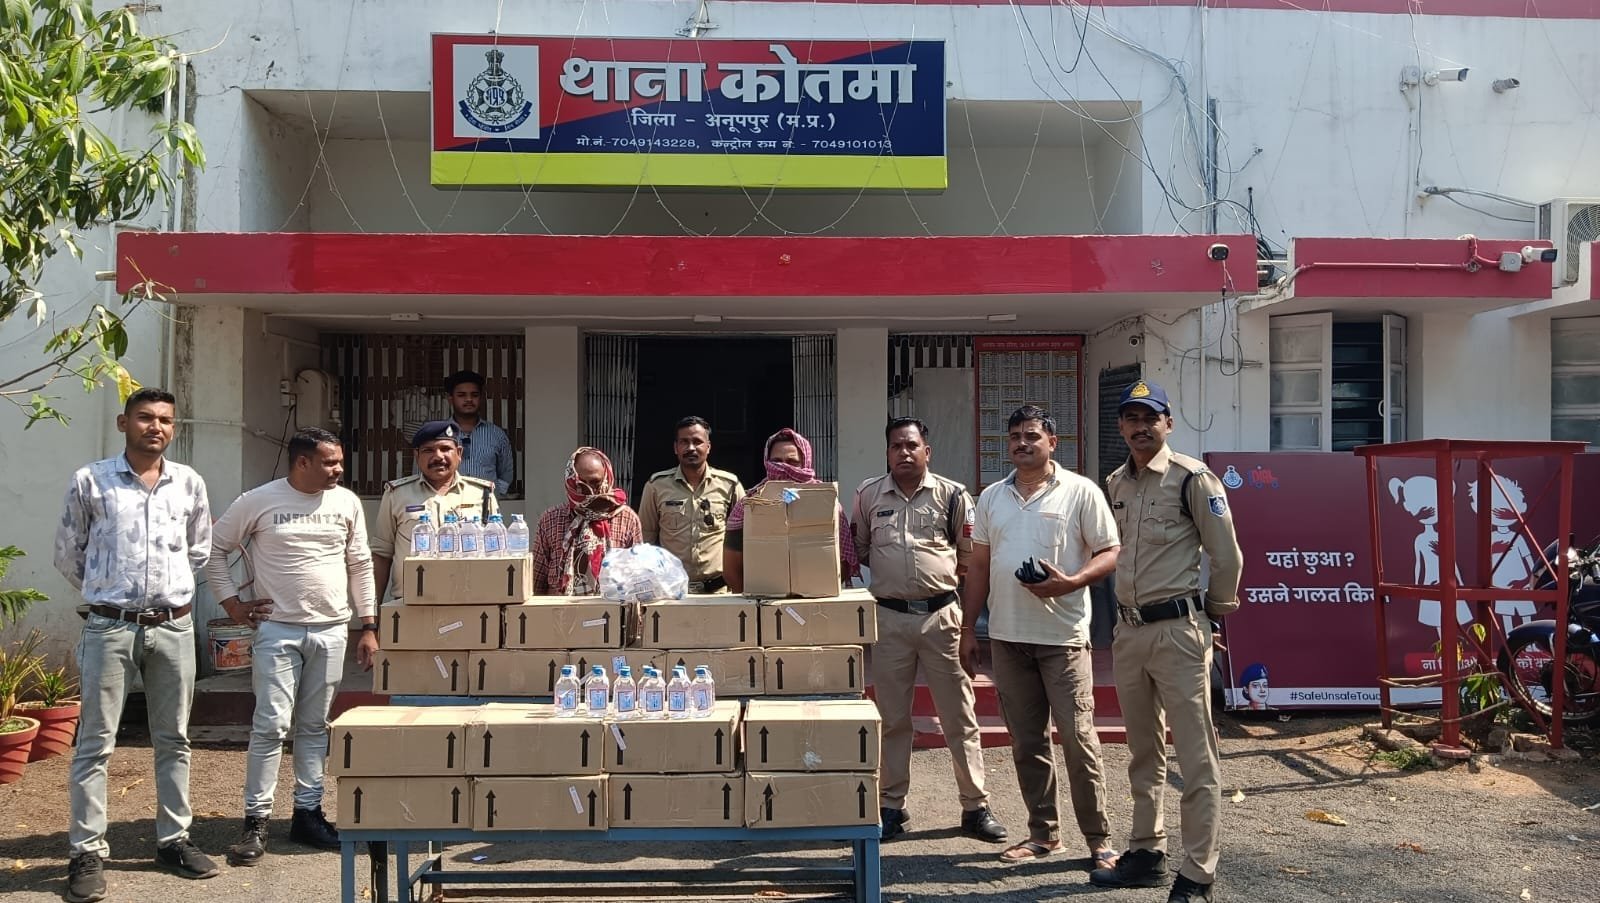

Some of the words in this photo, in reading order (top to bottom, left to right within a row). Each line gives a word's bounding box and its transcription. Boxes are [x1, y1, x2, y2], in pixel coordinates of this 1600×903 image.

[560, 57, 707, 102] थाना
[717, 44, 917, 103] कोतमा
[631, 107, 677, 127] जिला
[704, 113, 770, 133] अनूपपुर
[777, 112, 836, 131] (म.प्र.)
[813, 139, 892, 149] 7049101013
[1266, 547, 1300, 568] यहां
[1302, 552, 1341, 575] छुआ
[1344, 552, 1355, 567] ?
[1245, 582, 1289, 603] उसने
[1292, 587, 1341, 603] गलत
